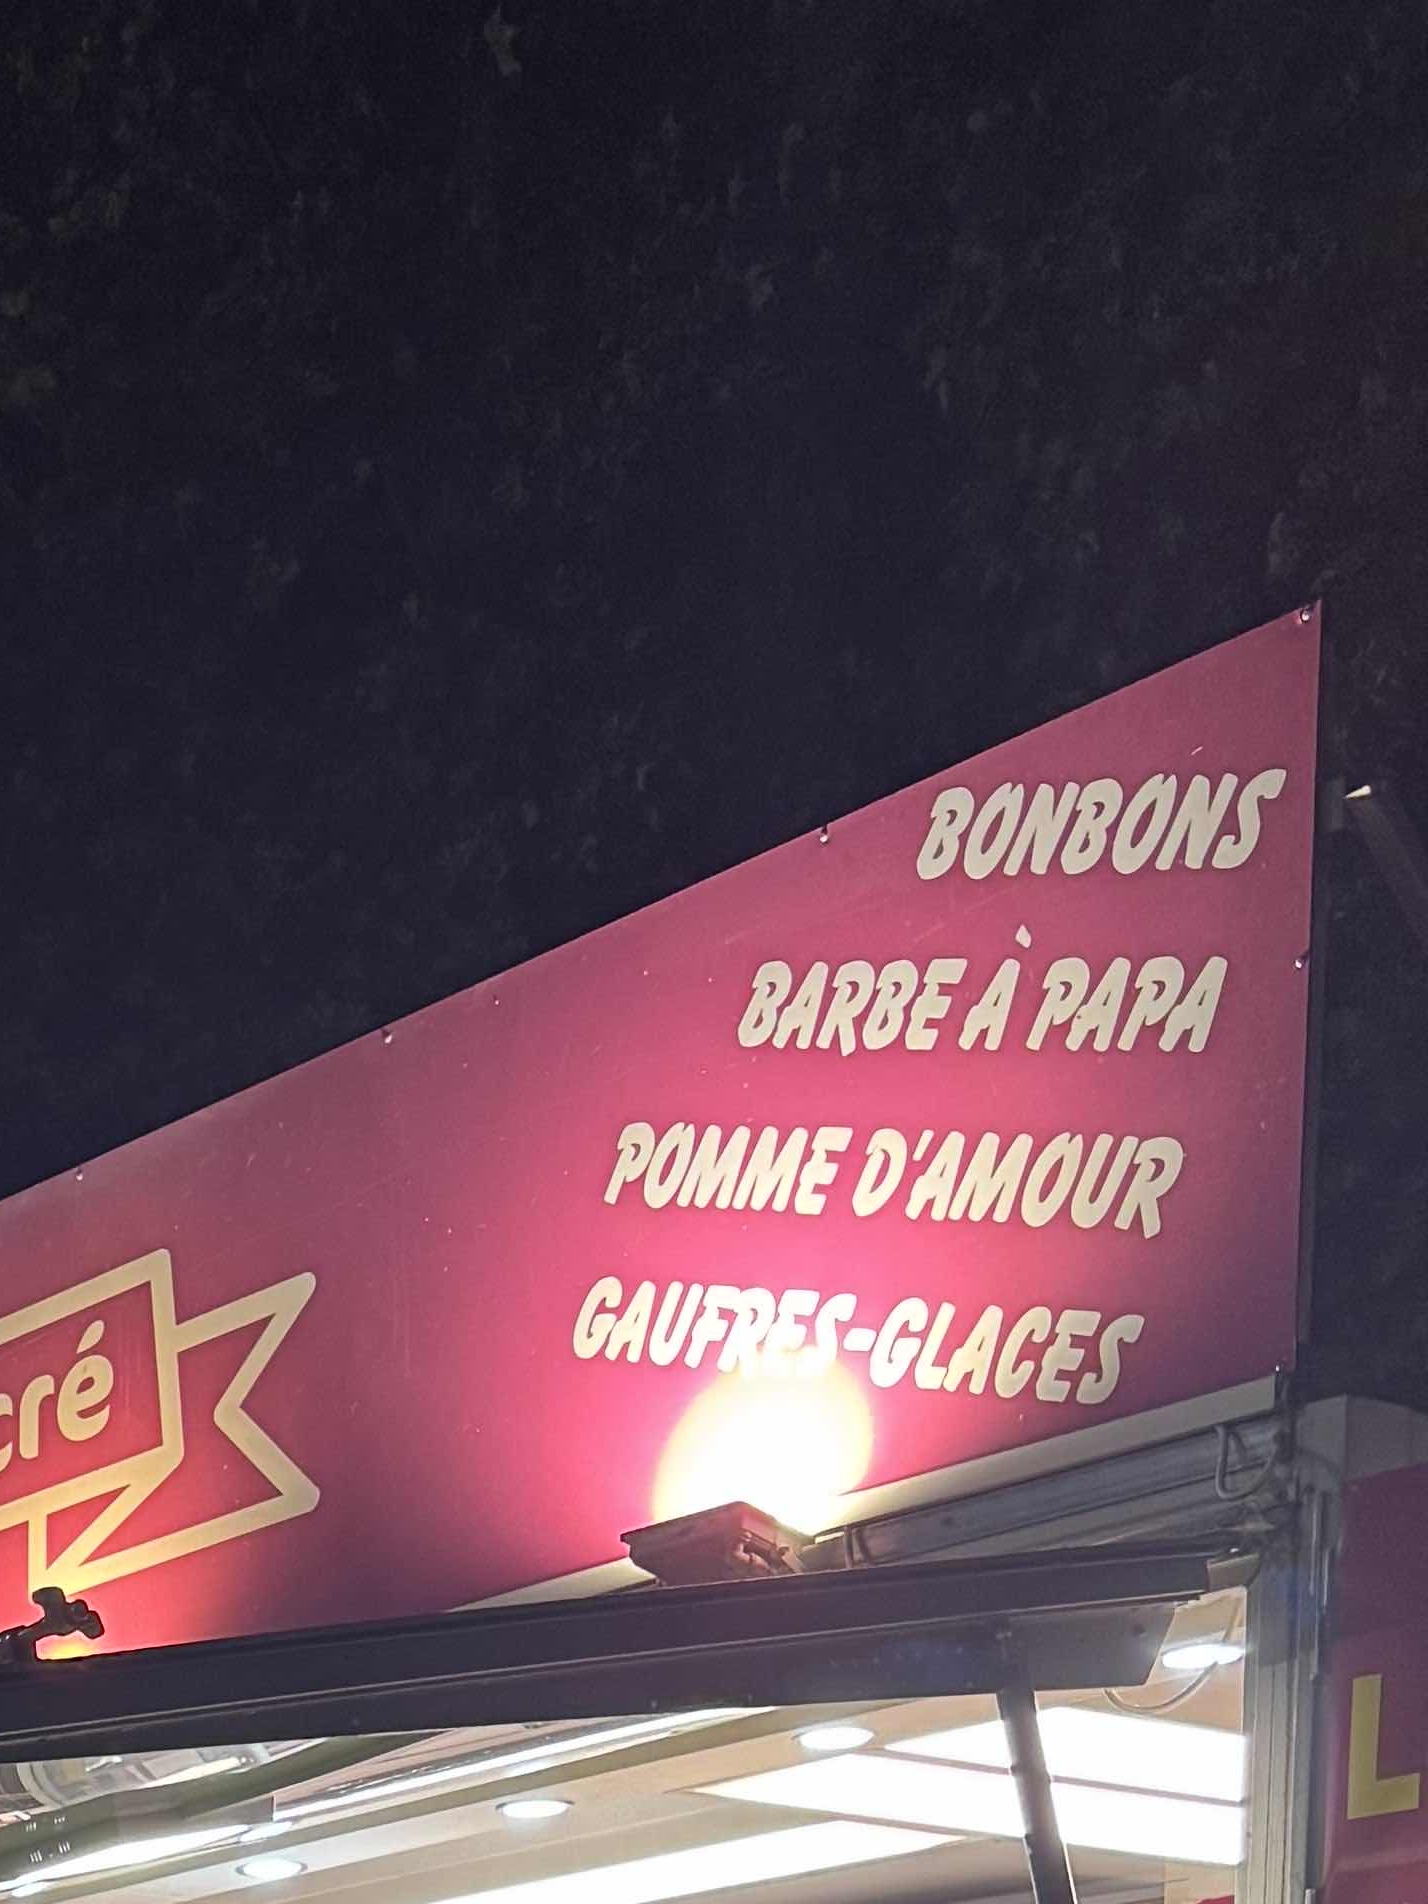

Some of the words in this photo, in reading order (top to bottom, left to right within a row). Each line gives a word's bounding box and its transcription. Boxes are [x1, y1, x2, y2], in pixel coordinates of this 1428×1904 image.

[916, 768, 1287, 880] BONBONS
[737, 958, 967, 1057] BARBE
[958, 924, 1033, 1052] À
[1026, 955, 1229, 1055] PAPA
[604, 1122, 852, 1217] POMME
[850, 1128, 1184, 1239] D'AMOUR
[573, 1276, 1145, 1405] GAUFRES-GLACES
[1347, 1673, 1422, 1820] L
